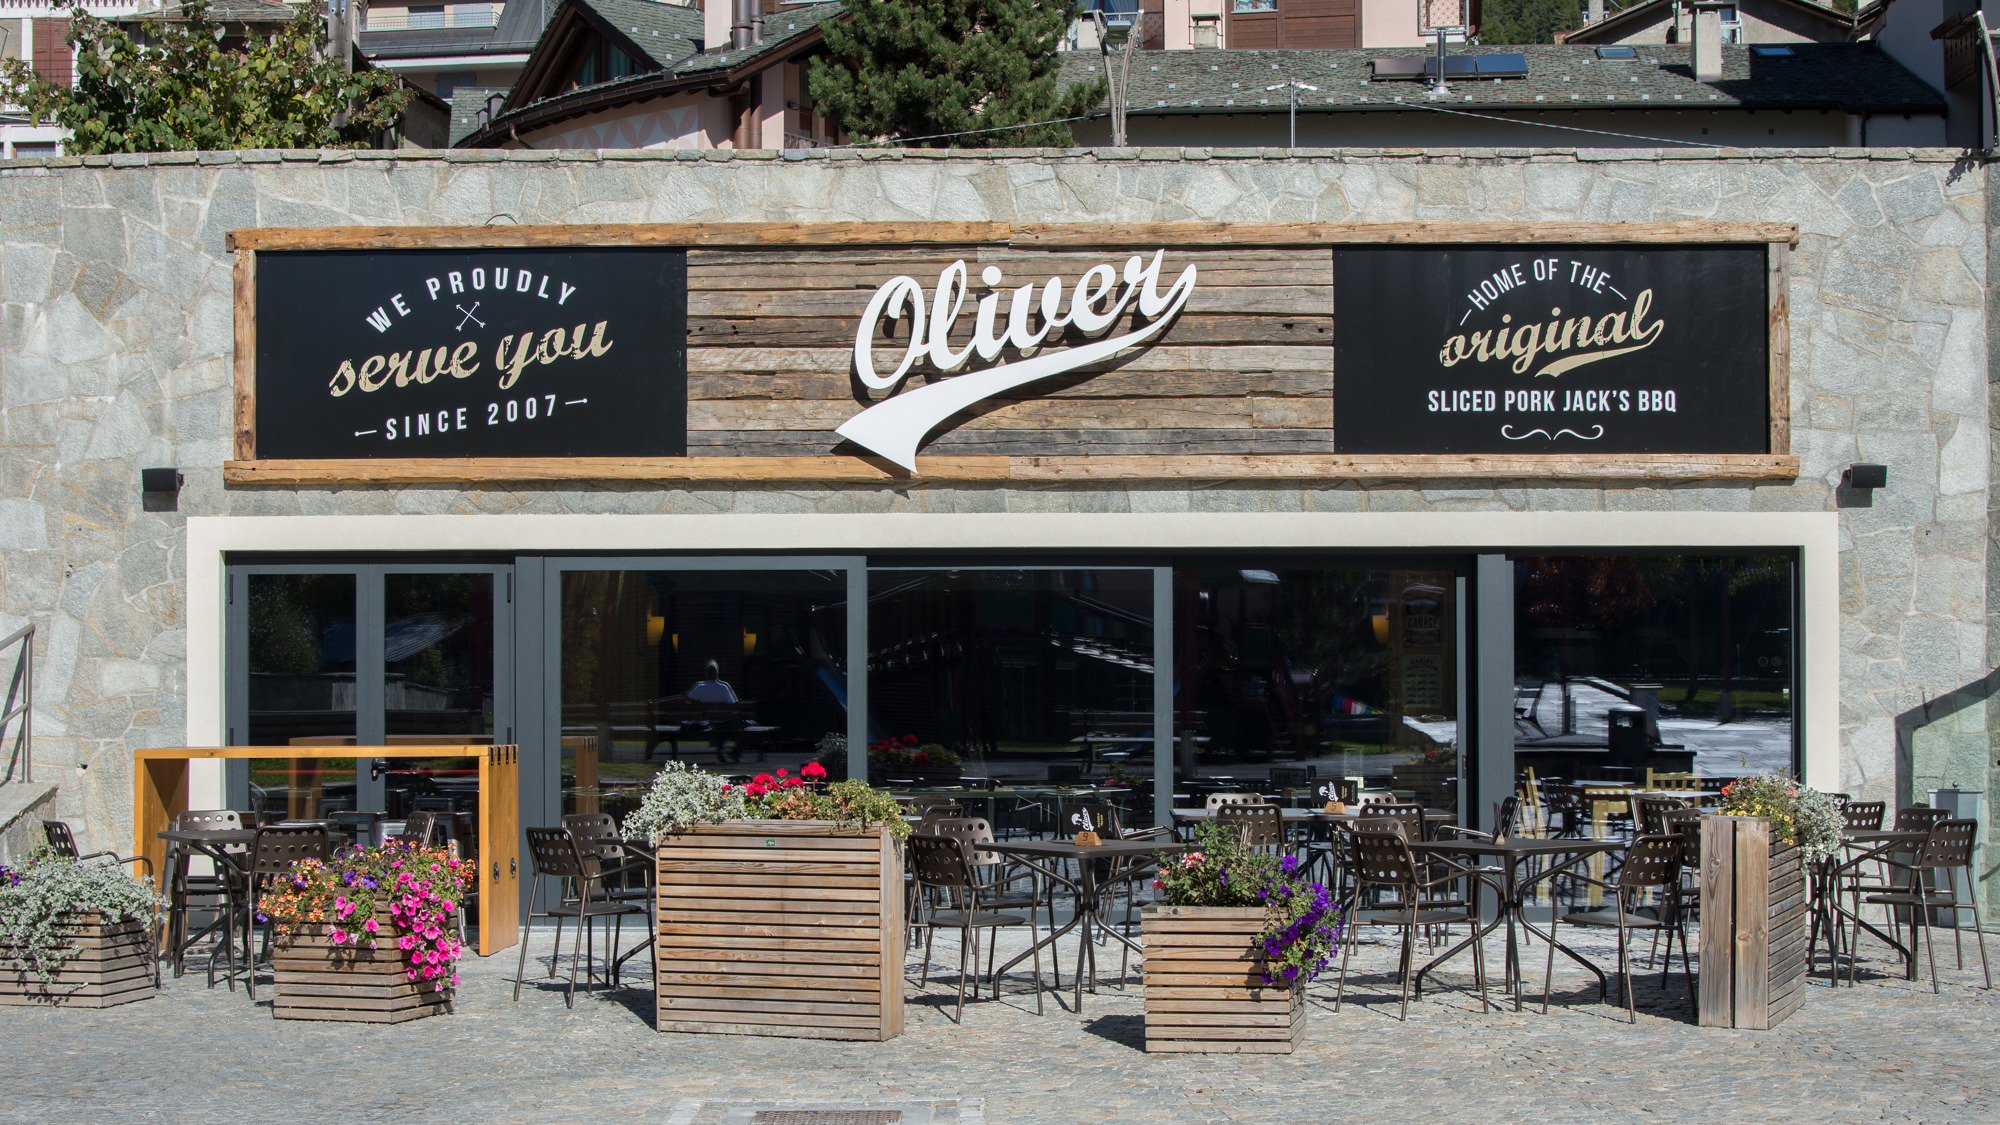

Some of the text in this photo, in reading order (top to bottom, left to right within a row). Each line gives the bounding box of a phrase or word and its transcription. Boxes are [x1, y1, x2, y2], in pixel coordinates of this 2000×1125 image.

[366, 267, 576, 333] WE PROUDLY
[1468, 259, 1611, 312] HOME OF THE
[854, 249, 1198, 390] Oliver
[1439, 288, 1665, 377] original
[329, 321, 613, 397] serve you
[386, 395, 555, 440] SINCE 2007
[1428, 390, 1676, 412] SLICED PORK JACK'S BBQ
[1408, 617, 1438, 629] GARAGE
[1332, 803, 1337, 811] 5
[1082, 832, 1088, 841] 9
